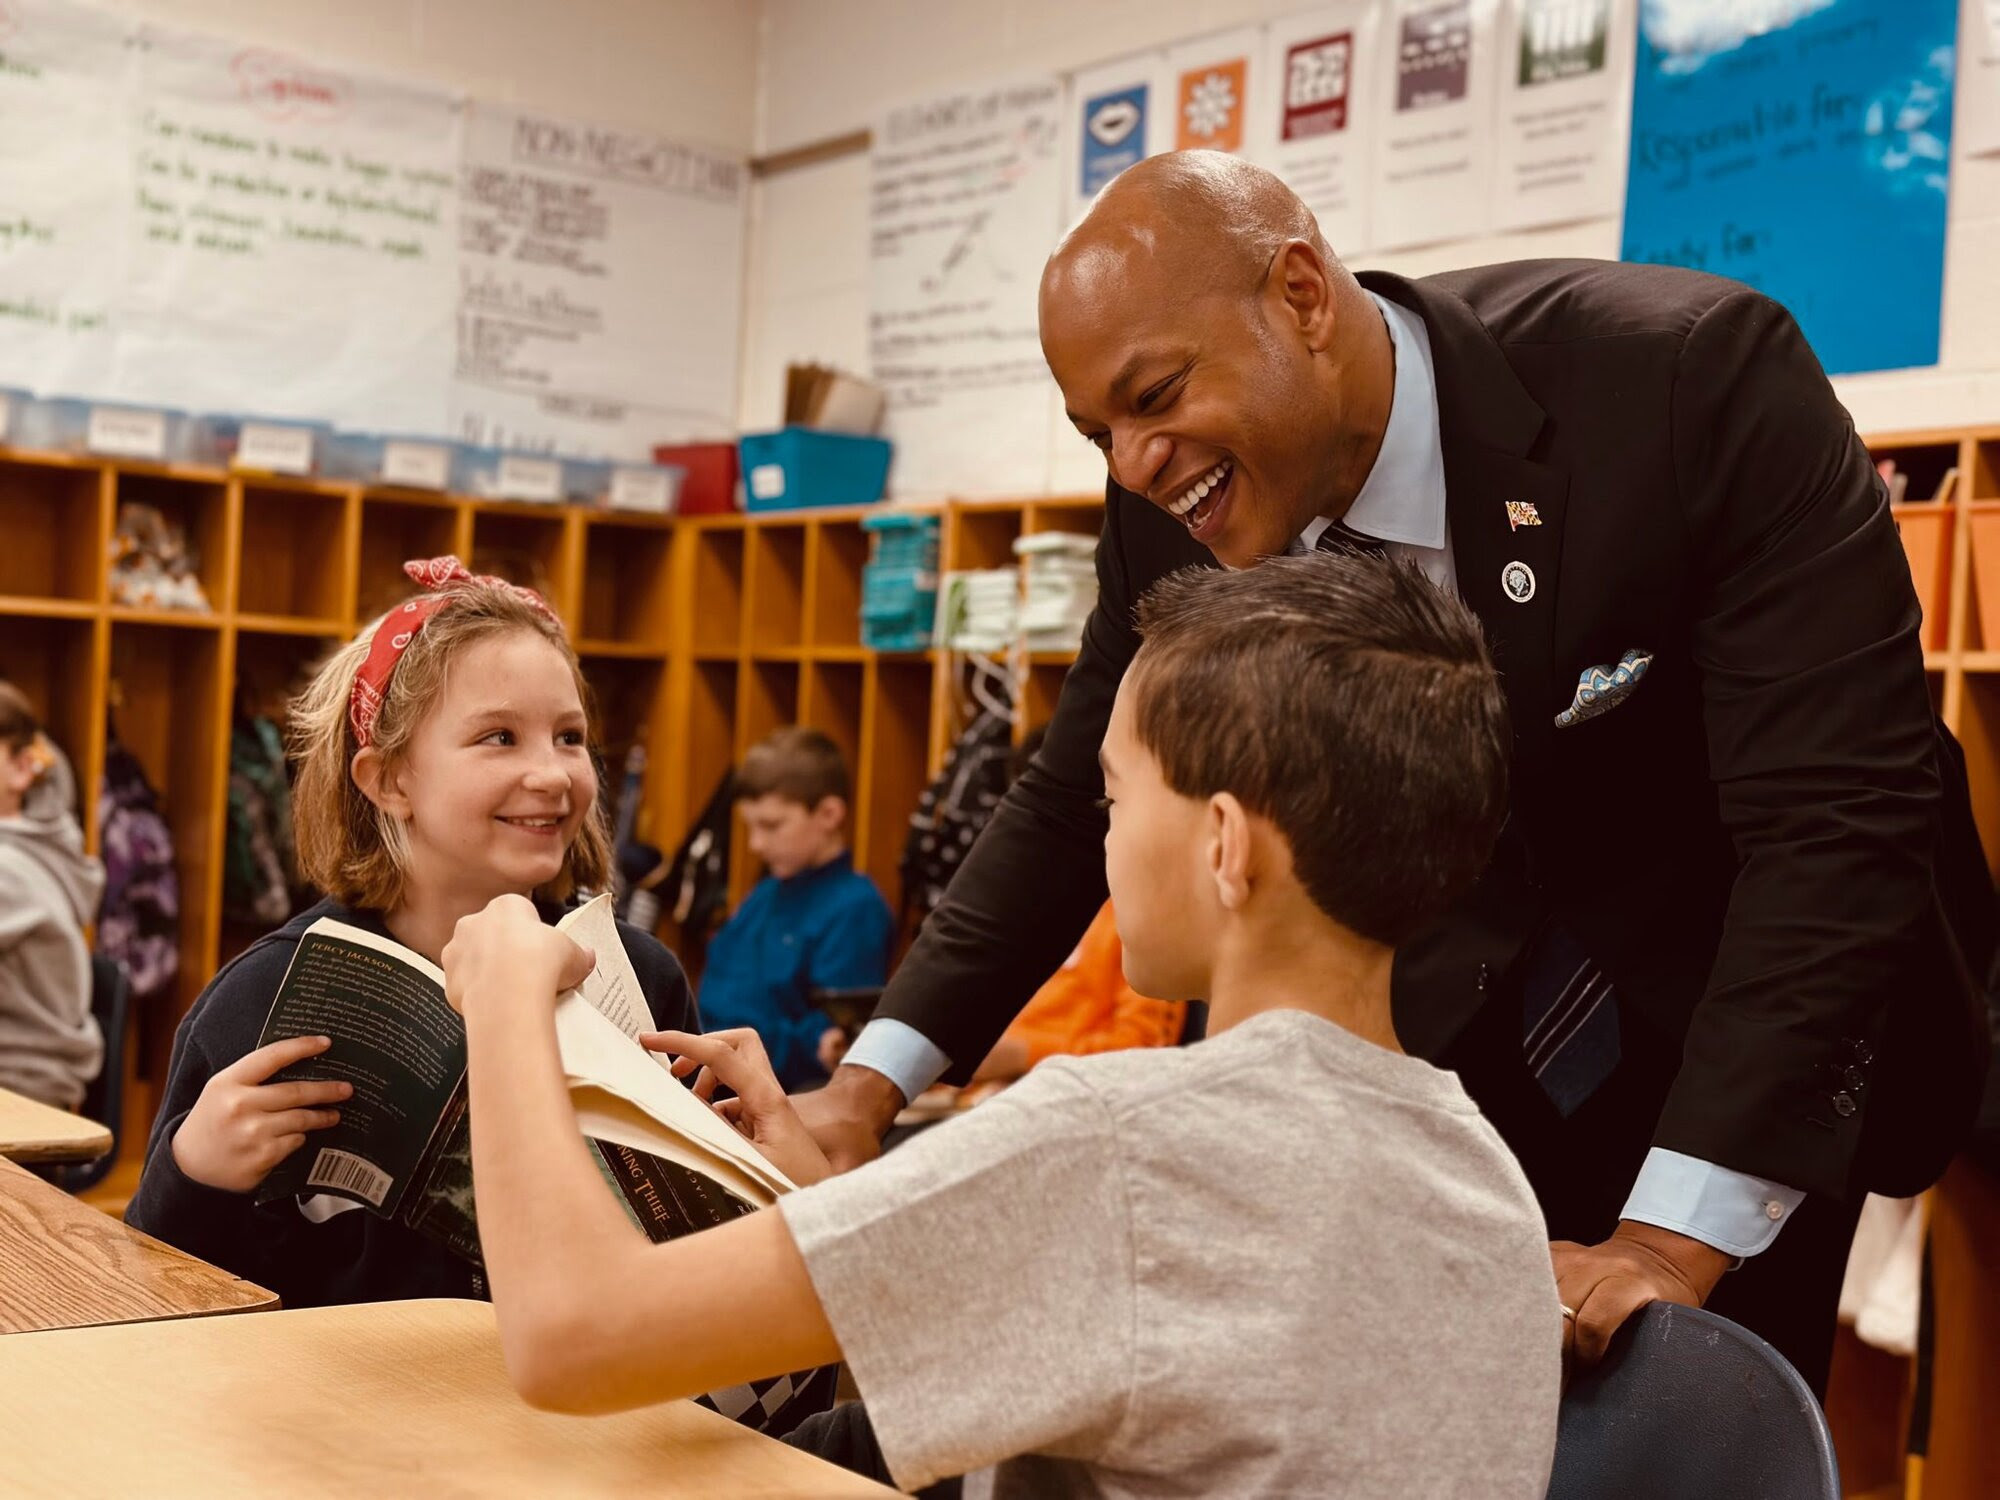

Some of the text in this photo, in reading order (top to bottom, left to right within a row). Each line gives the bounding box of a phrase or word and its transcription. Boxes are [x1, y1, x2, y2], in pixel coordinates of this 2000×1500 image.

[311, 942, 394, 972] PERCY JACKSON
[634, 1175, 671, 1222] THIEF
